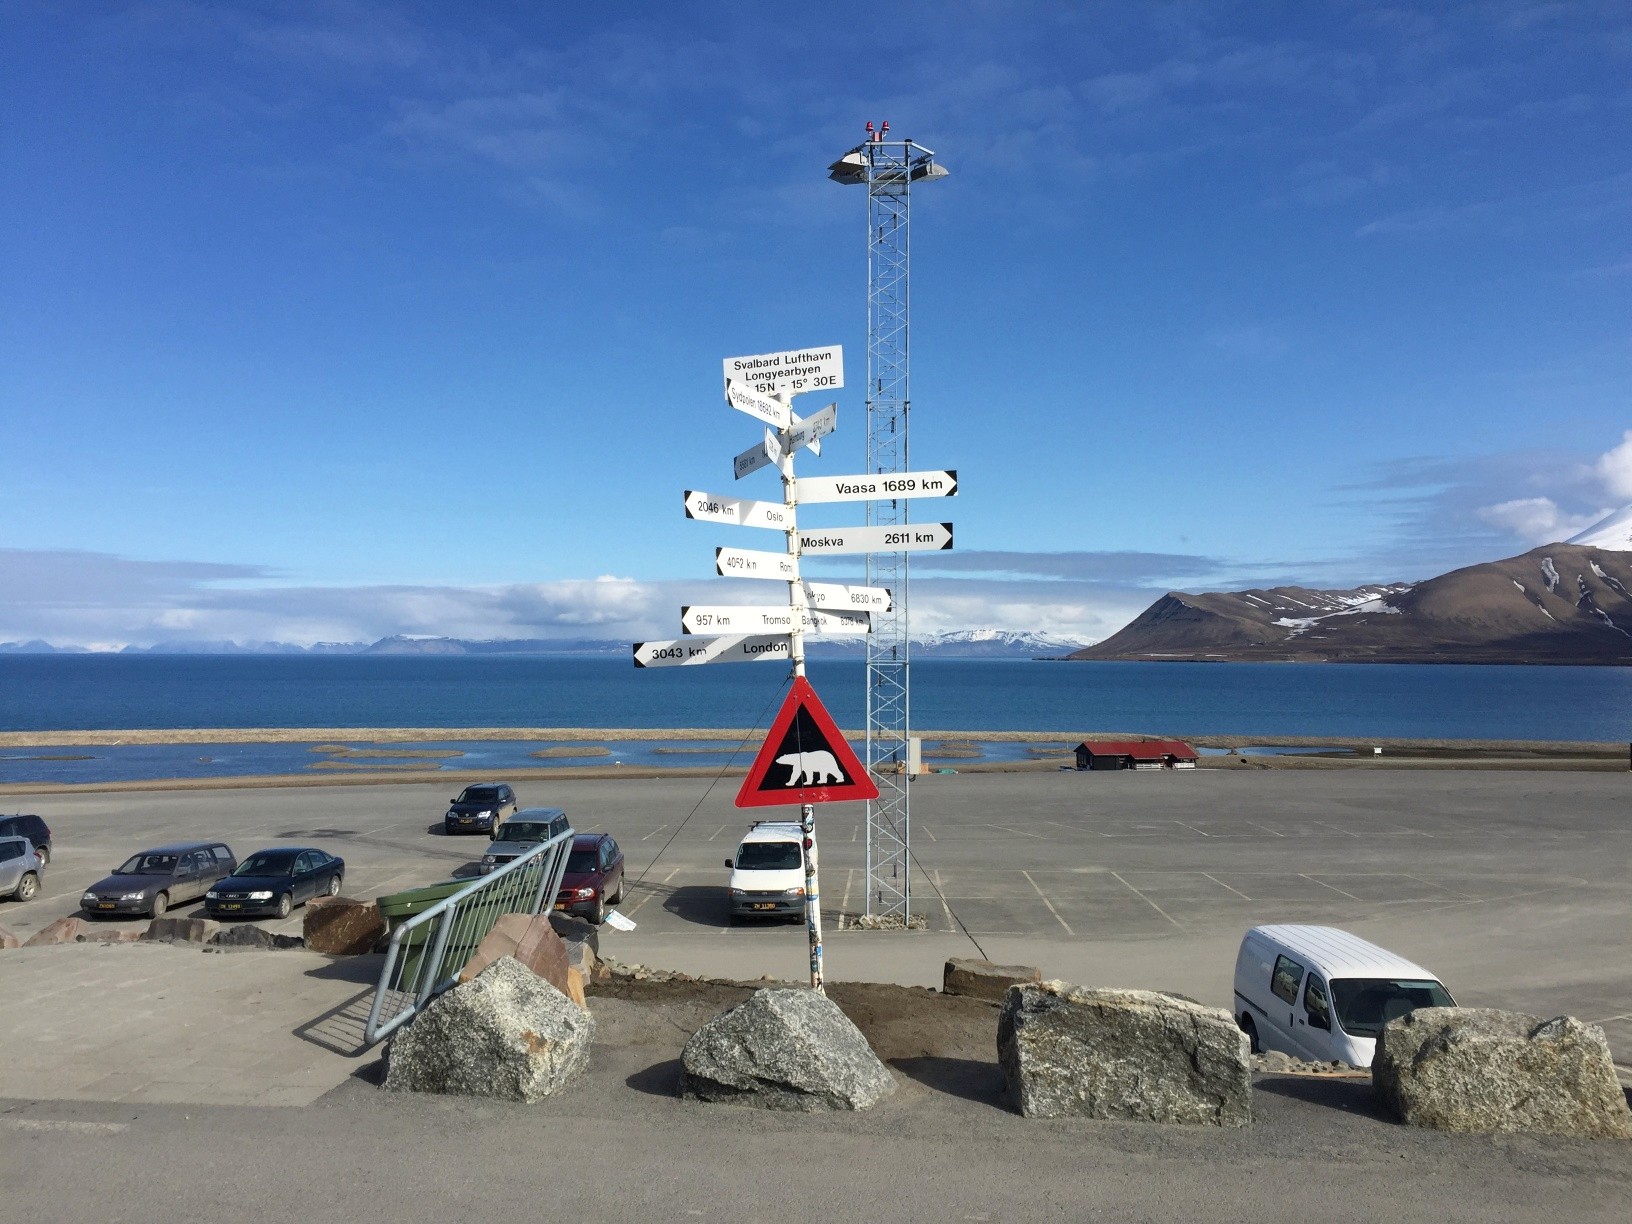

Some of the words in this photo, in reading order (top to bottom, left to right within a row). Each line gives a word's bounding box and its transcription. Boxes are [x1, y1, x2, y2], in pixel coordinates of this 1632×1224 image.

[734, 357, 780, 371] Svalbard
[785, 352, 832, 365] Lufthavn
[745, 365, 821, 381] Longyearbyen
[836, 482, 876, 494] Vaasa
[883, 480, 916, 492] 1689
[922, 477, 943, 490] km
[697, 500, 719, 514] 2046
[721, 504, 734, 516] km
[766, 510, 784, 523] Oslo
[801, 537, 844, 548] Moskva
[884, 533, 910, 545] 2611
[915, 532, 934, 543] km
[726, 557, 744, 569] 4052
[746, 558, 757, 570] km
[850, 593, 870, 604] 6830
[871, 595, 883, 605] km
[695, 614, 713, 626] 957
[716, 615, 731, 626] km
[801, 615, 828, 628] Bangkok
[652, 648, 684, 660] 3043
[688, 647, 708, 657] km
[743, 642, 788, 654] London
